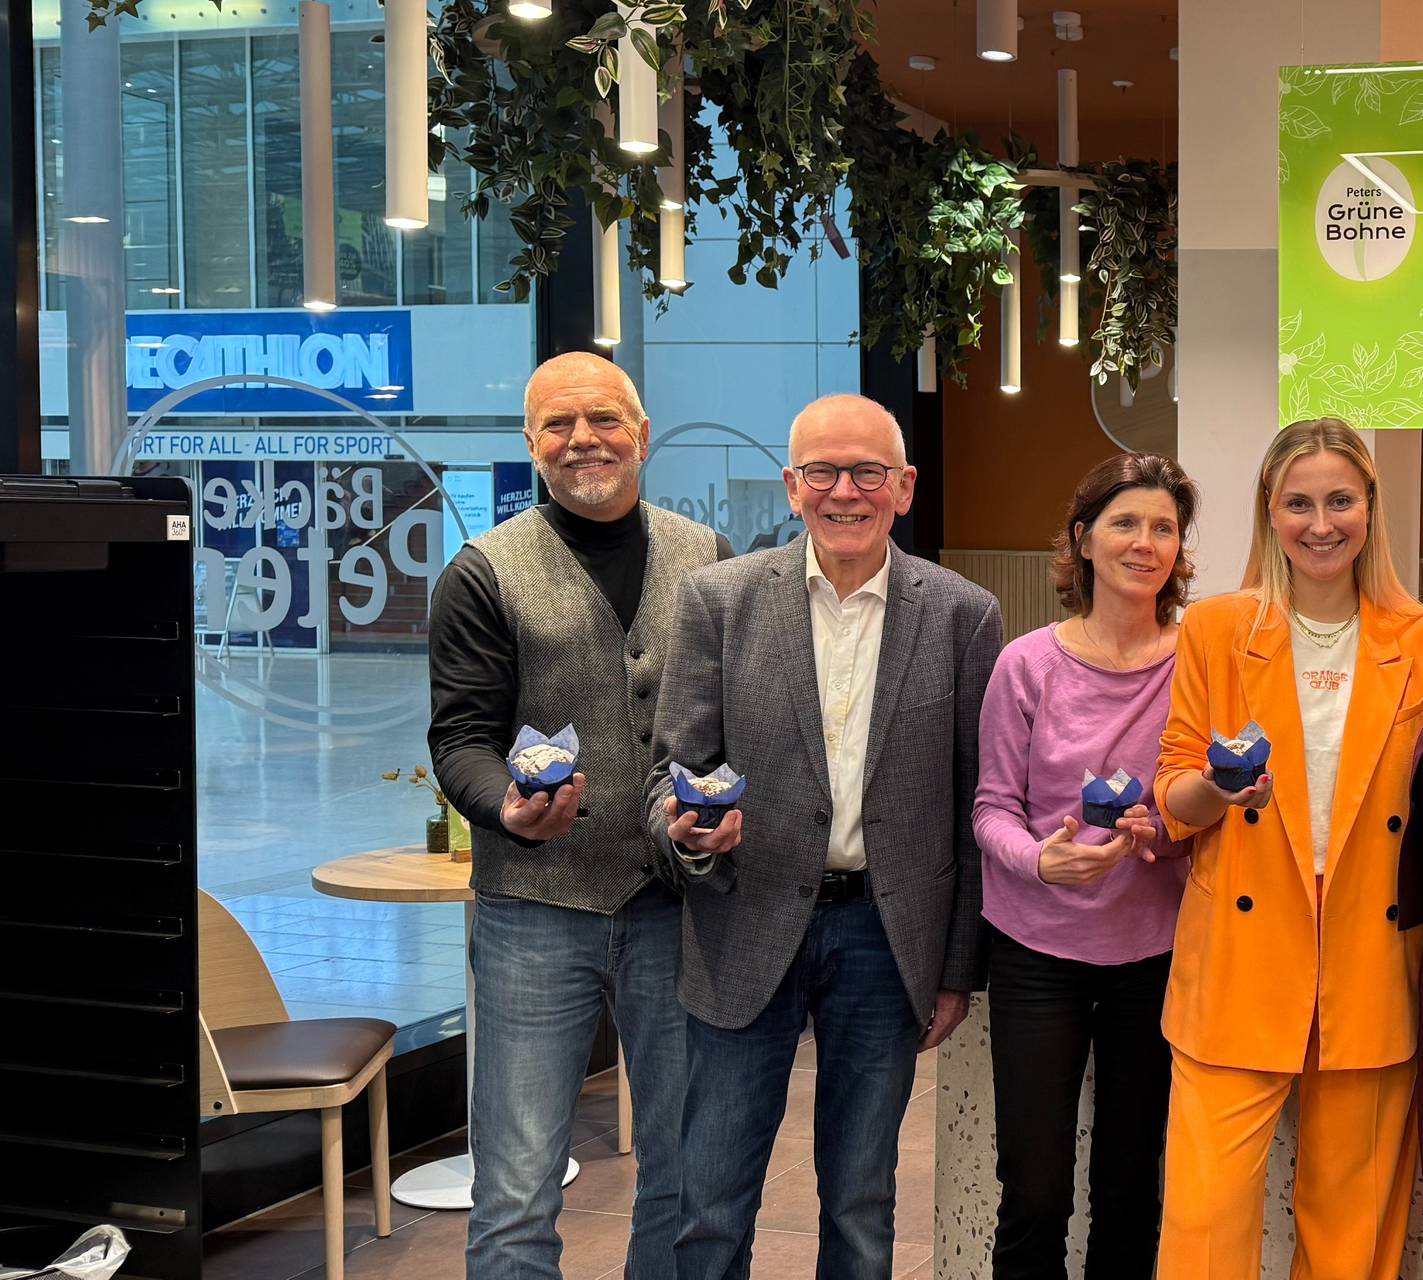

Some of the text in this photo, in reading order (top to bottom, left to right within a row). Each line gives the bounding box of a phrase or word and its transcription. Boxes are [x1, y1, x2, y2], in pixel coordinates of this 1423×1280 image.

[1346, 187, 1382, 198] Peters
[1328, 201, 1404, 221] Grüne
[1326, 222, 1406, 241] Bohne
[126, 333, 390, 390] ECATHLON
[170, 436, 204, 455] FOR
[208, 436, 243, 454] ALL
[254, 436, 289, 454] ALL
[294, 436, 329, 455] FOR
[334, 436, 395, 455] SPORT
[500, 489, 532, 505] HERZLIC
[496, 500, 532, 515] WILLKOM
[172, 521, 187, 529] AHA
[1302, 670, 1348, 682] ORANGE
[1310, 680, 1340, 690] CLUB
